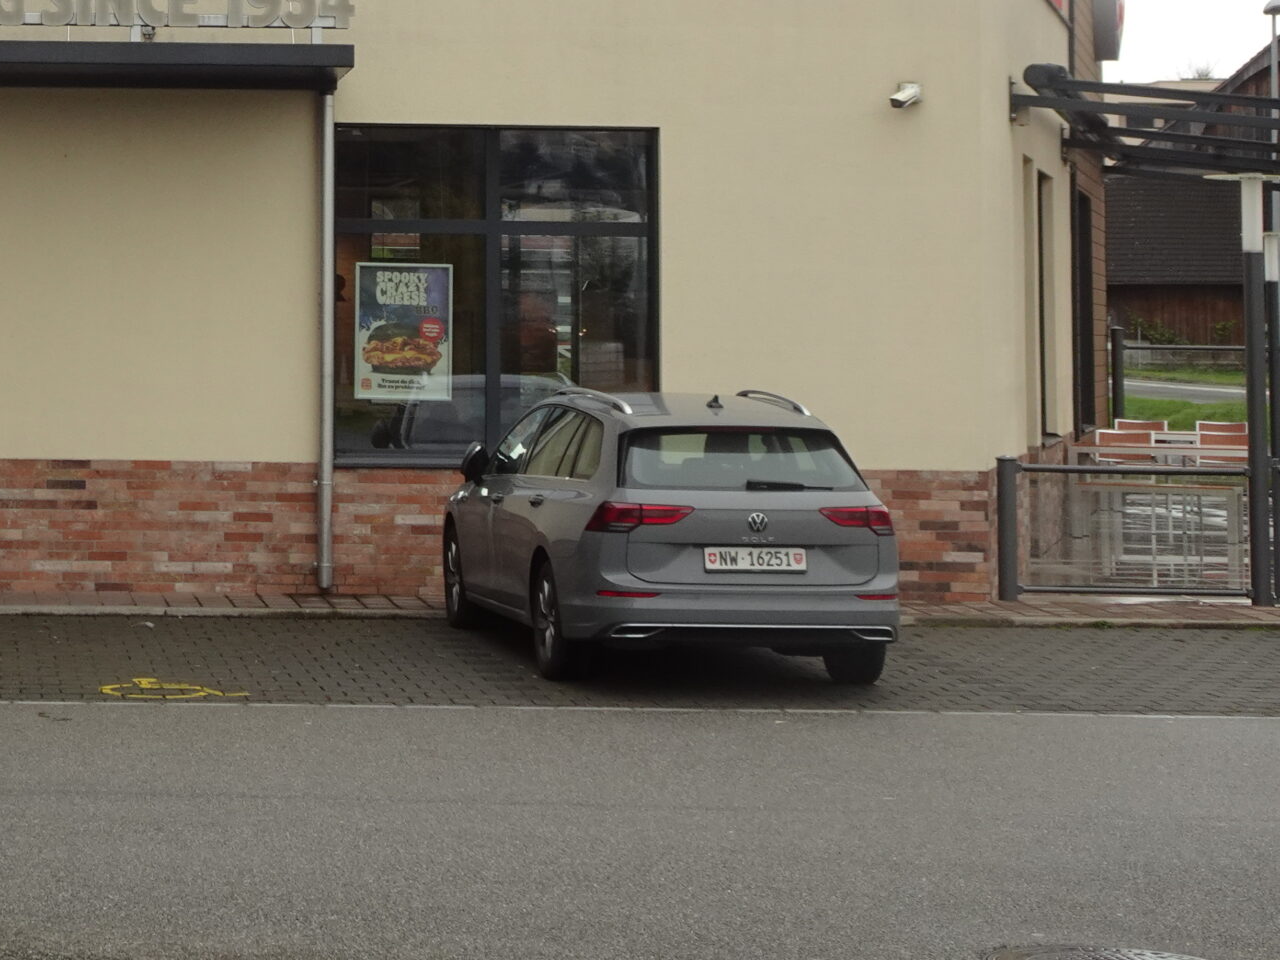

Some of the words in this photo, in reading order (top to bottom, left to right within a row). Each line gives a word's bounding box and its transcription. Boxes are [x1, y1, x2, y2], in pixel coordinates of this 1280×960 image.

[376, 271, 428, 283] SPOOKY
[376, 281, 428, 298] CRAZY
[376, 290, 427, 305] CHEESE
